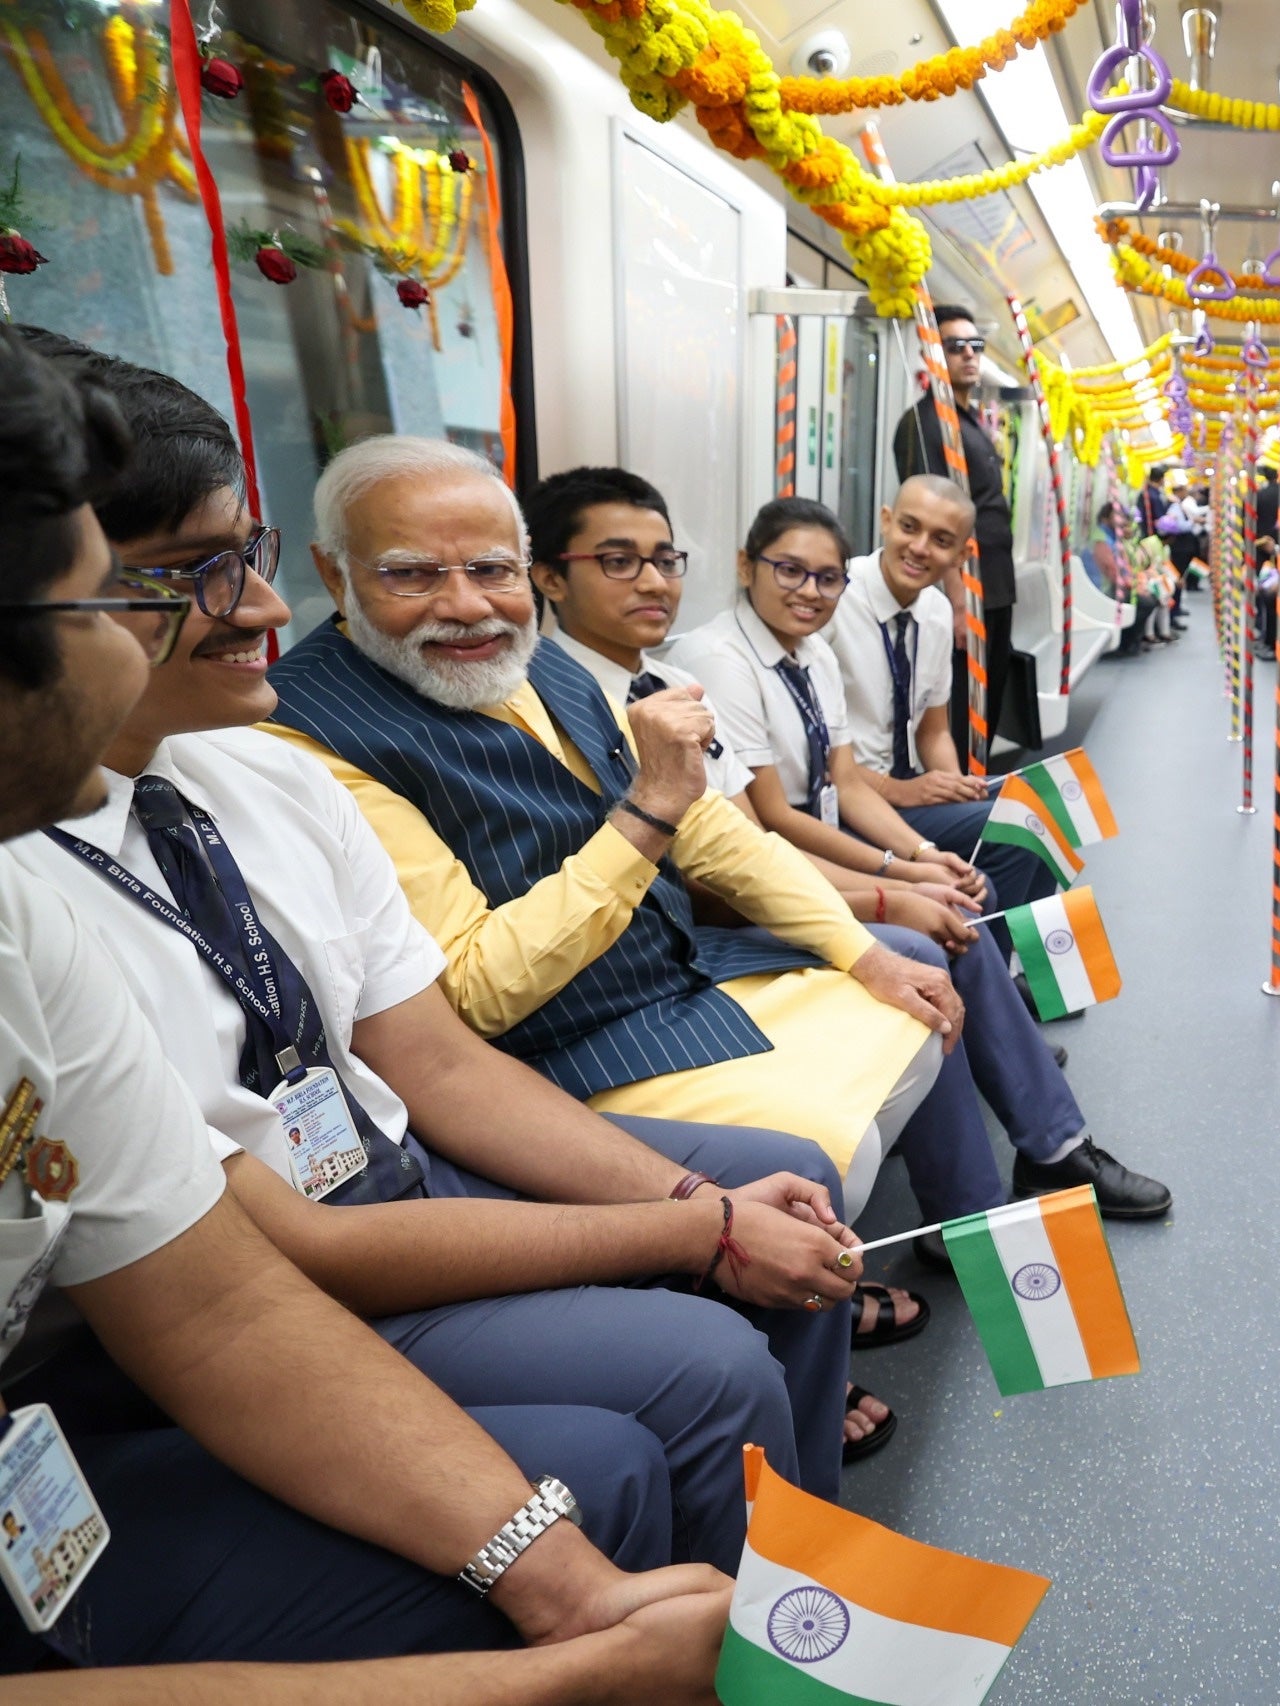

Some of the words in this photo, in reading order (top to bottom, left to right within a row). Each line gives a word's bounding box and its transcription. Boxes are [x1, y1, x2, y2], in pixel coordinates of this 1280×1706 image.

[200, 822, 221, 845] M.P.
[74, 841, 105, 866] M.P.
[107, 864, 142, 893] Birla
[143, 891, 212, 954] Foundation
[213, 953, 233, 979] H.S.
[236, 977, 270, 1017] School
[235, 902, 262, 946] School
[254, 948, 272, 976] H.S.
